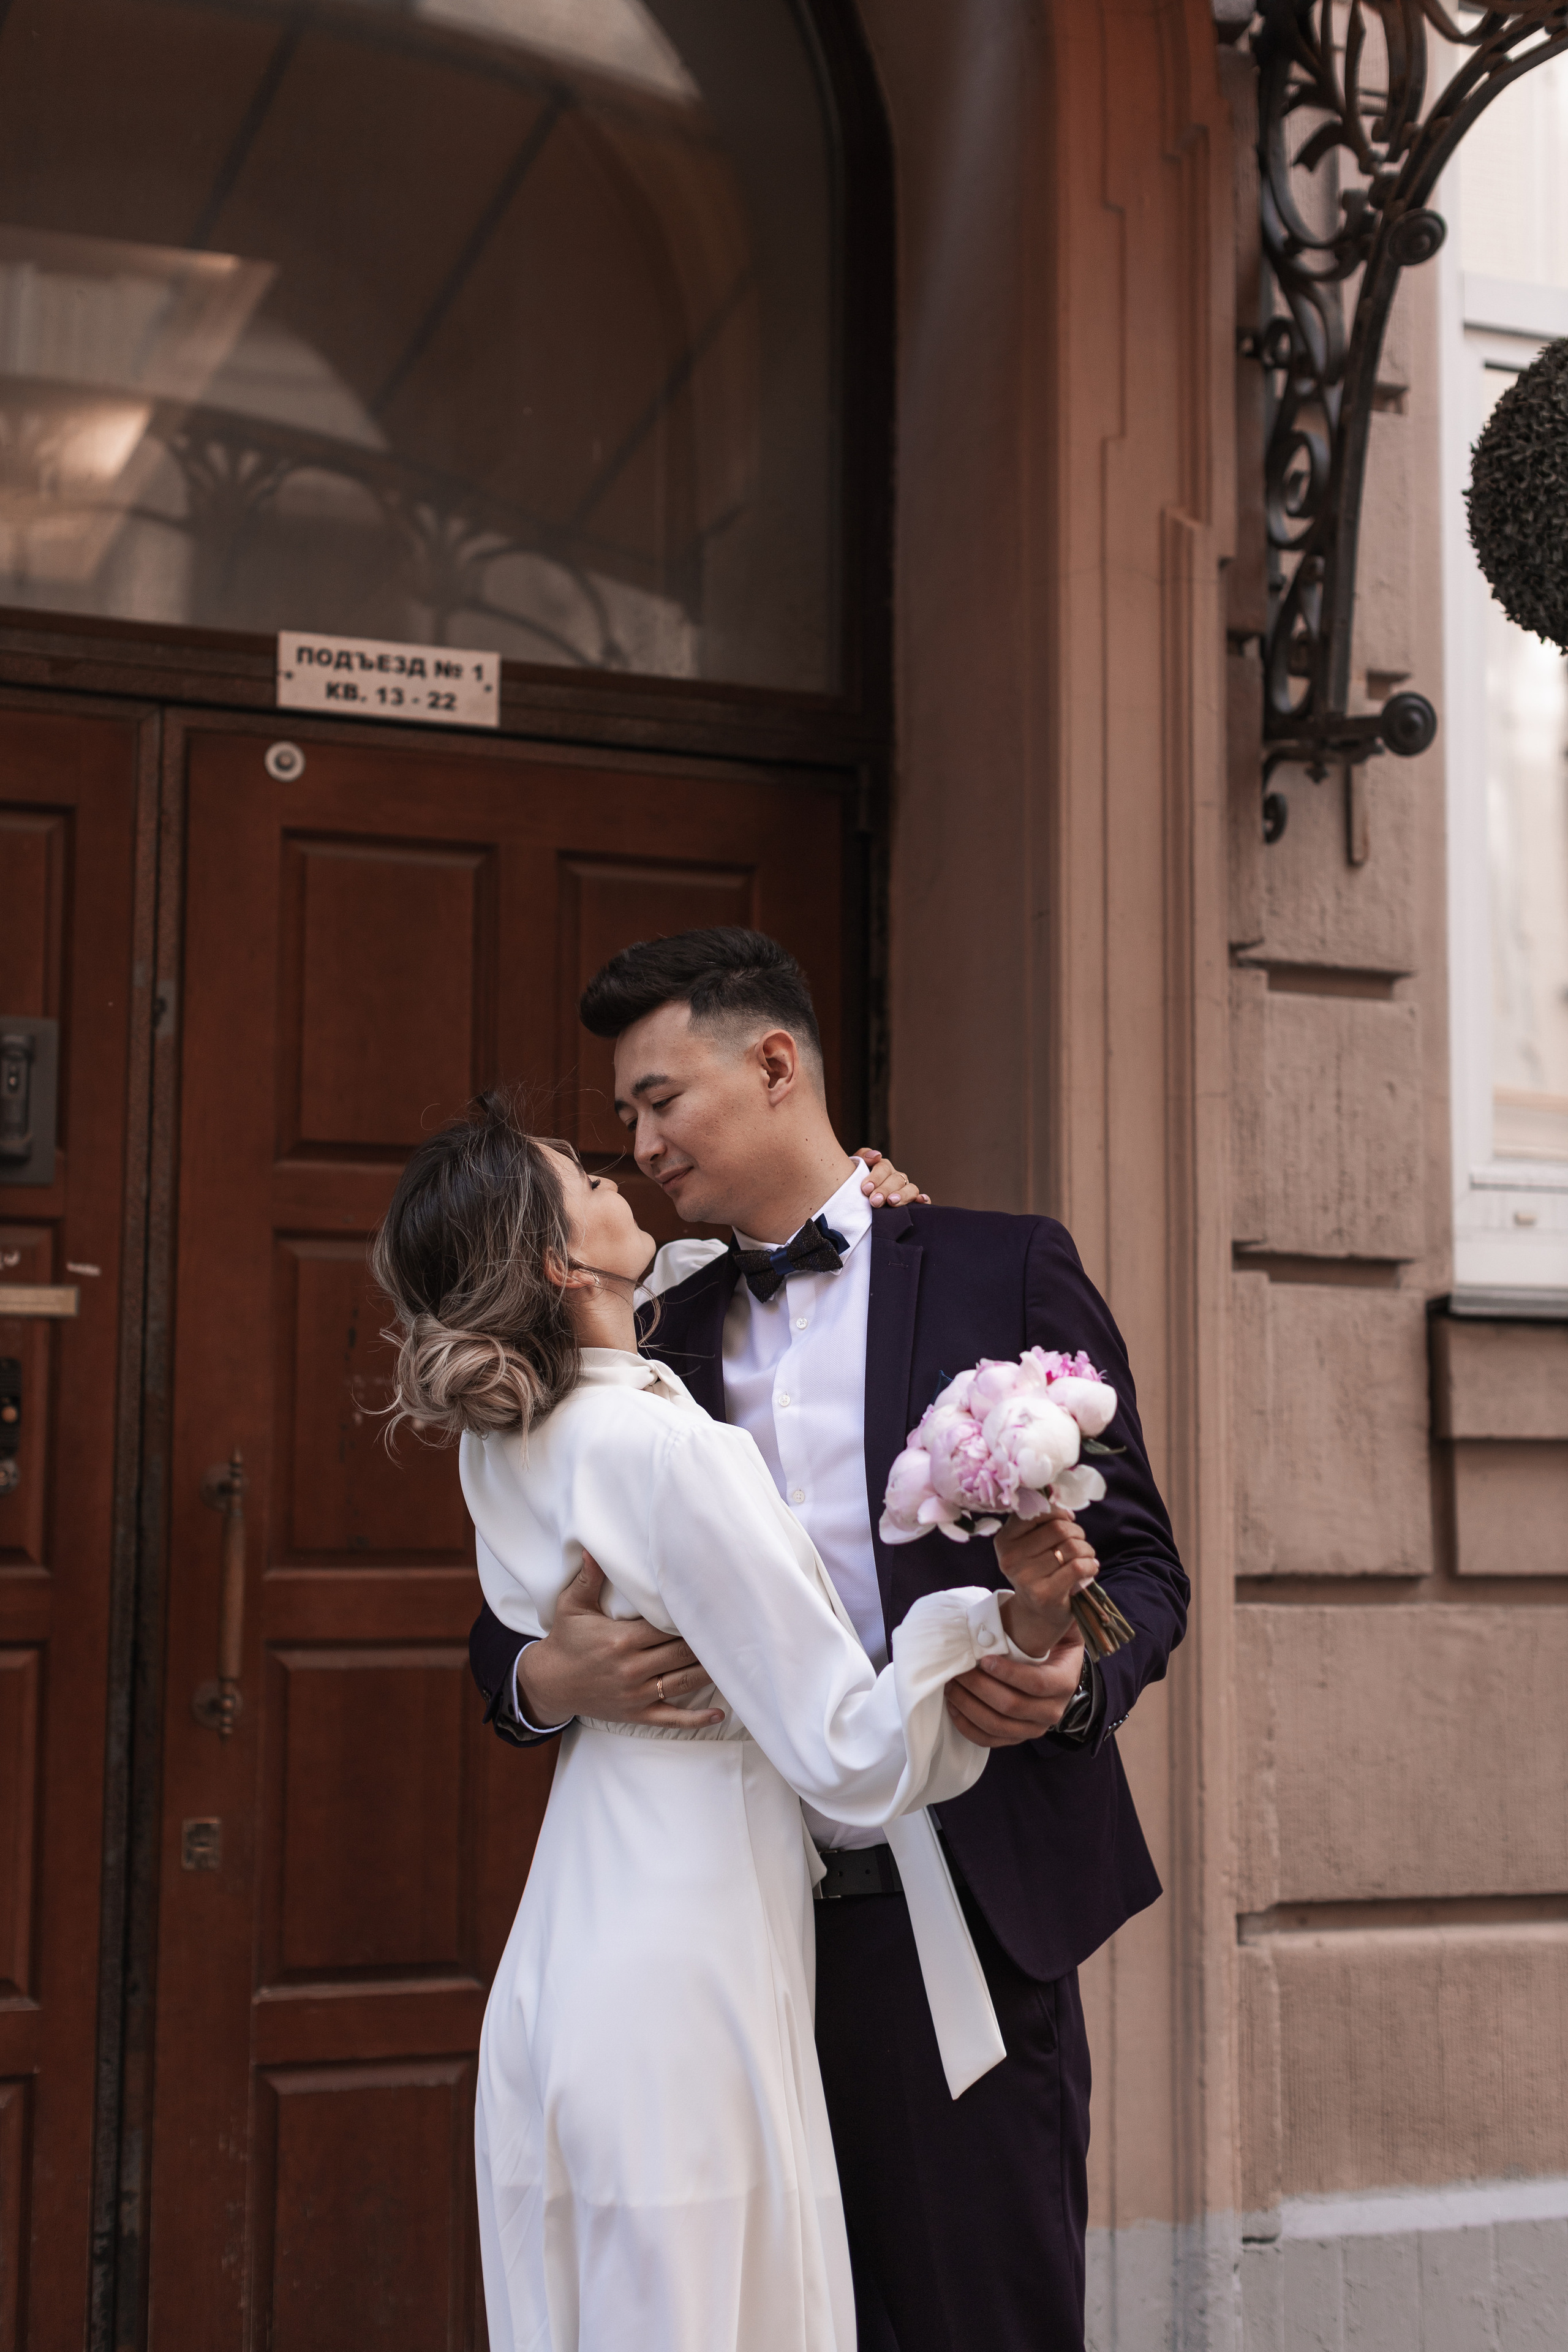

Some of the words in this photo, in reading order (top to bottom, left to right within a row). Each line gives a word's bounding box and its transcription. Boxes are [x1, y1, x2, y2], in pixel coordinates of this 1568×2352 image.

[296, 646, 426, 679] ПОДЪЕЗД
[434, 660, 463, 679] №
[473, 665, 483, 681] 1
[326, 682, 367, 702] КВ.
[377, 687, 404, 706] 13
[428, 692, 457, 711] 22
